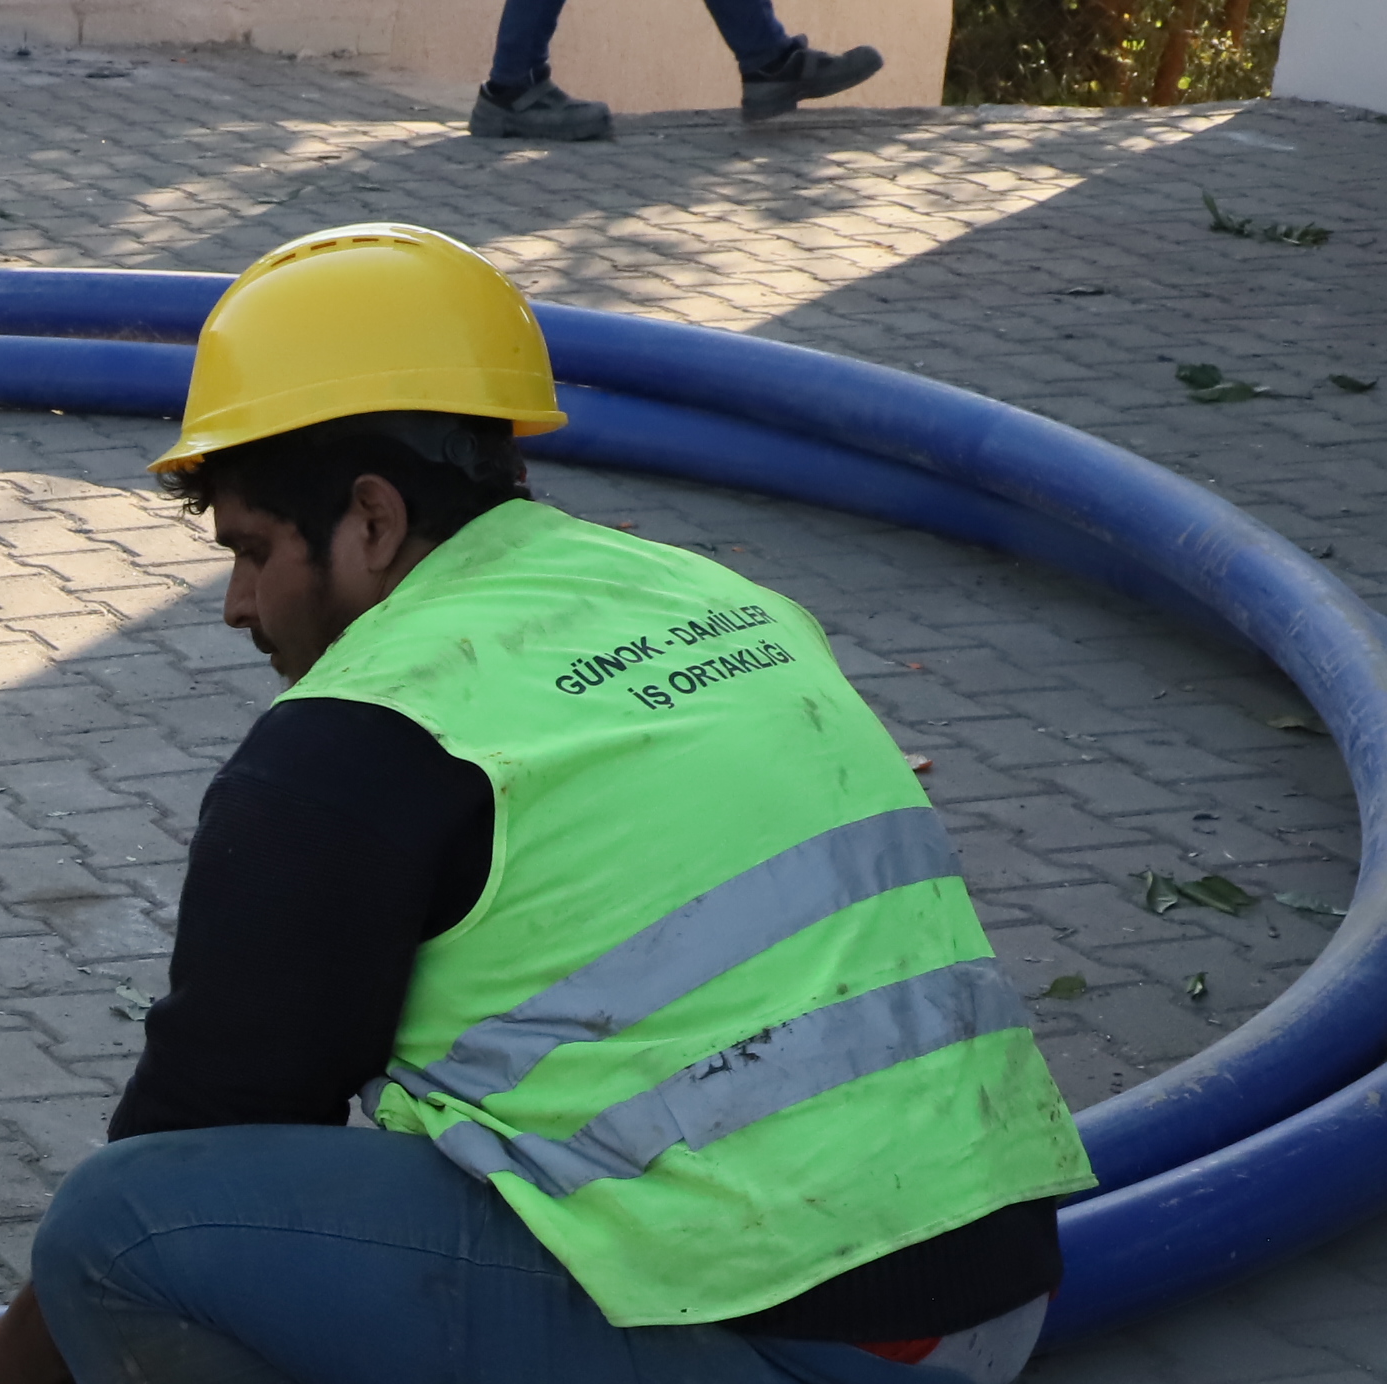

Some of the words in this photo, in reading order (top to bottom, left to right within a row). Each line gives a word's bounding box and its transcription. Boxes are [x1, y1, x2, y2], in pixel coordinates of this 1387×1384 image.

[555, 636, 665, 695] GÜNOK
[627, 684, 675, 710] İŞ
[668, 639, 796, 695] ORTAKLIĞI
